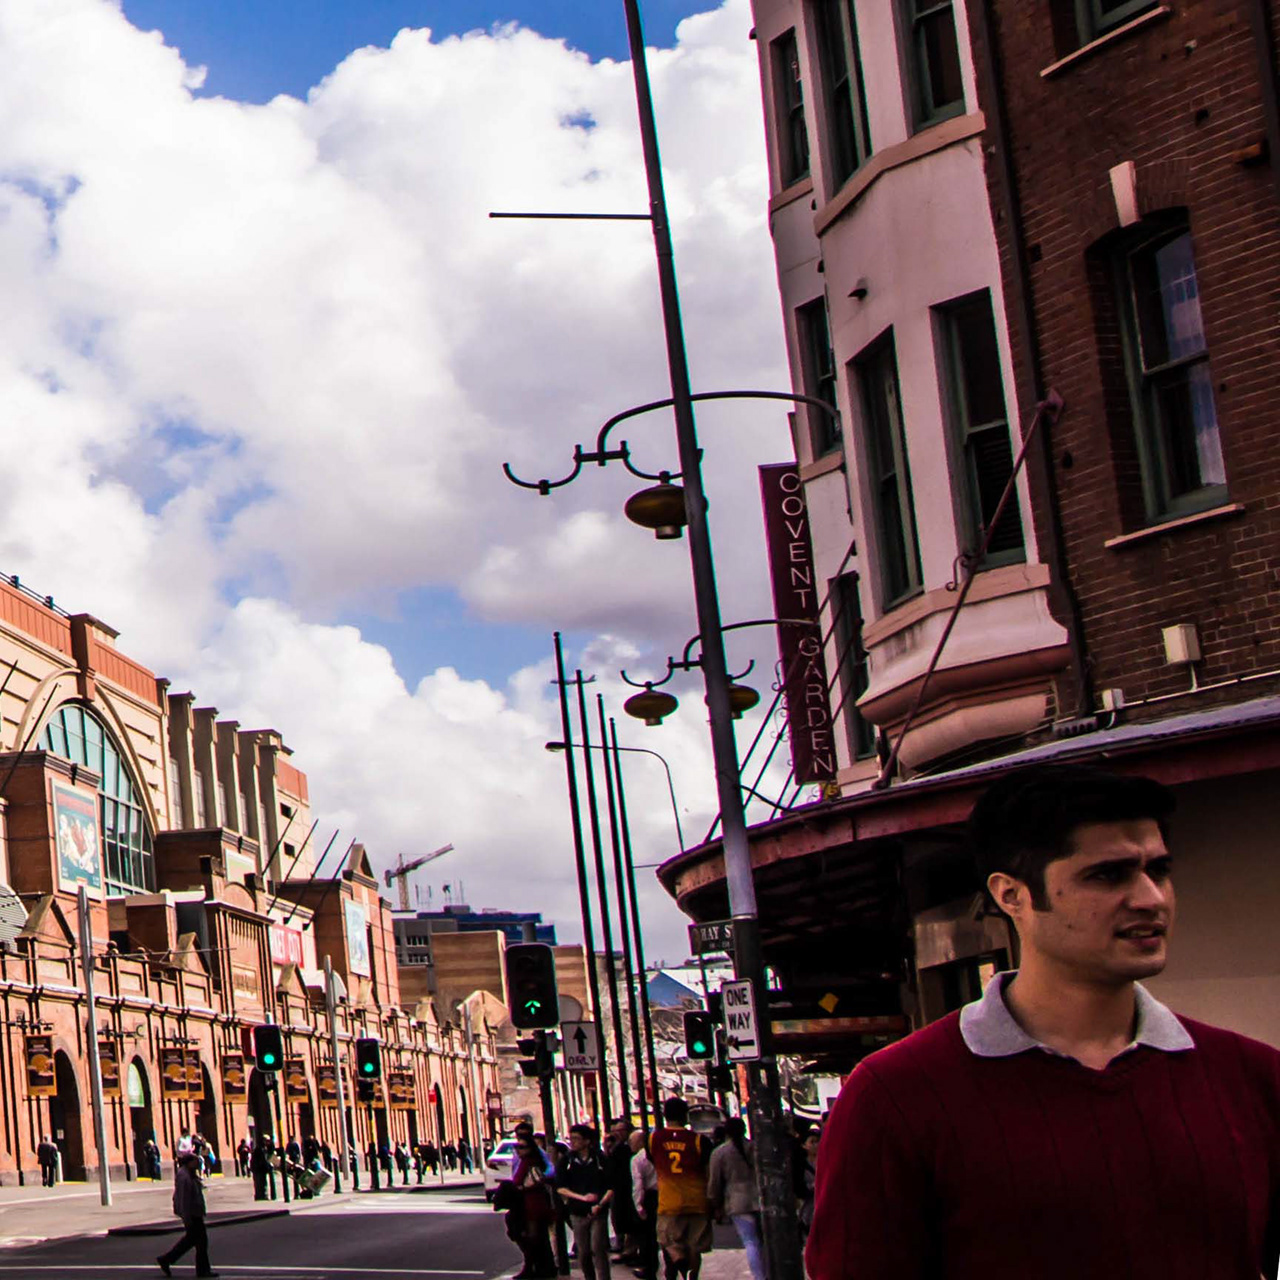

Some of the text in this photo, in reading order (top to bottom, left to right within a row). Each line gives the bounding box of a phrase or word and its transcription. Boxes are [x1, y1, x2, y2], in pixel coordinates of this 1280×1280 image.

[779, 472, 812, 608] COVENT
[798, 636, 834, 775] GARDEN
[726, 986, 749, 1007] ONE
[727, 1011, 751, 1031] WAY
[567, 1054, 597, 1067] ONLY
[668, 1151, 683, 1174] 2
